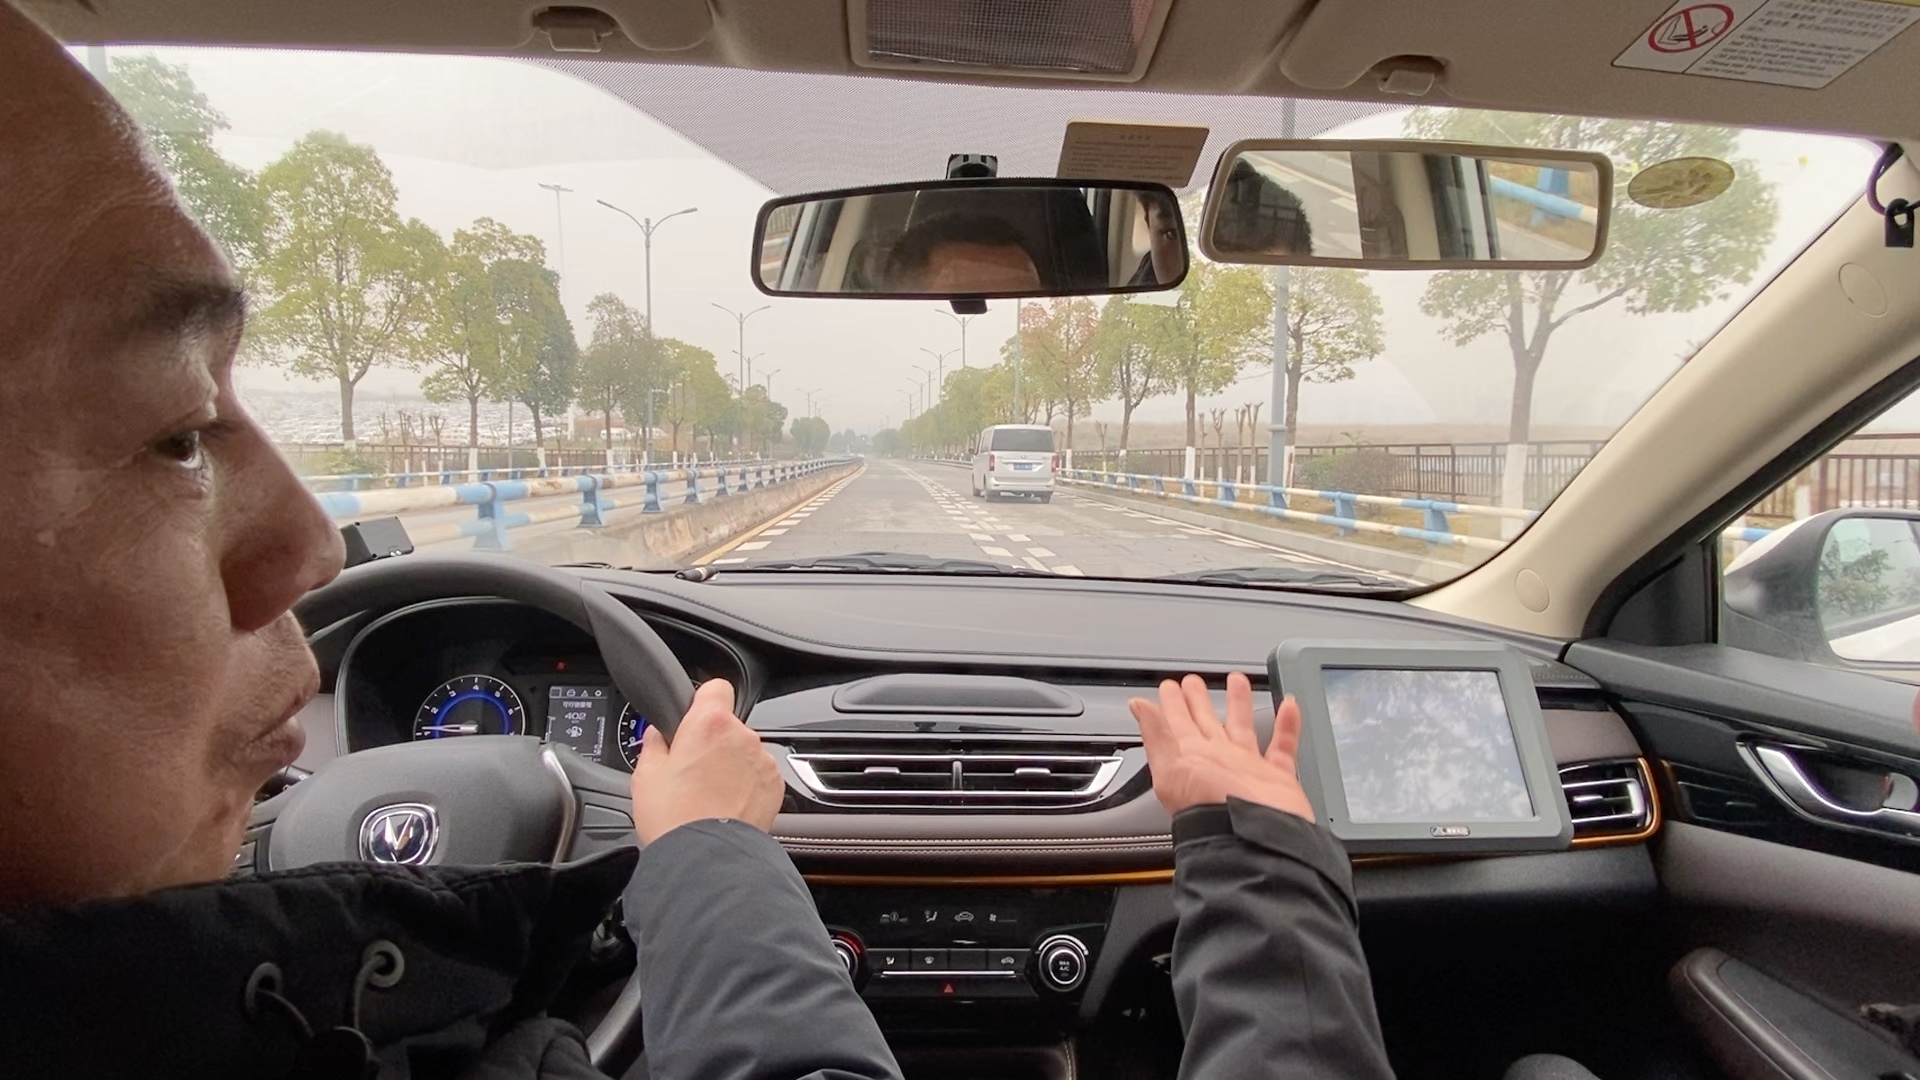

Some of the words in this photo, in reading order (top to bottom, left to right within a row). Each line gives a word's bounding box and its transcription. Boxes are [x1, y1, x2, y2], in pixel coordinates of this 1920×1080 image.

[448, 689, 457, 697] 3
[430, 706, 439, 715] 2
[564, 712, 587, 720] 402
